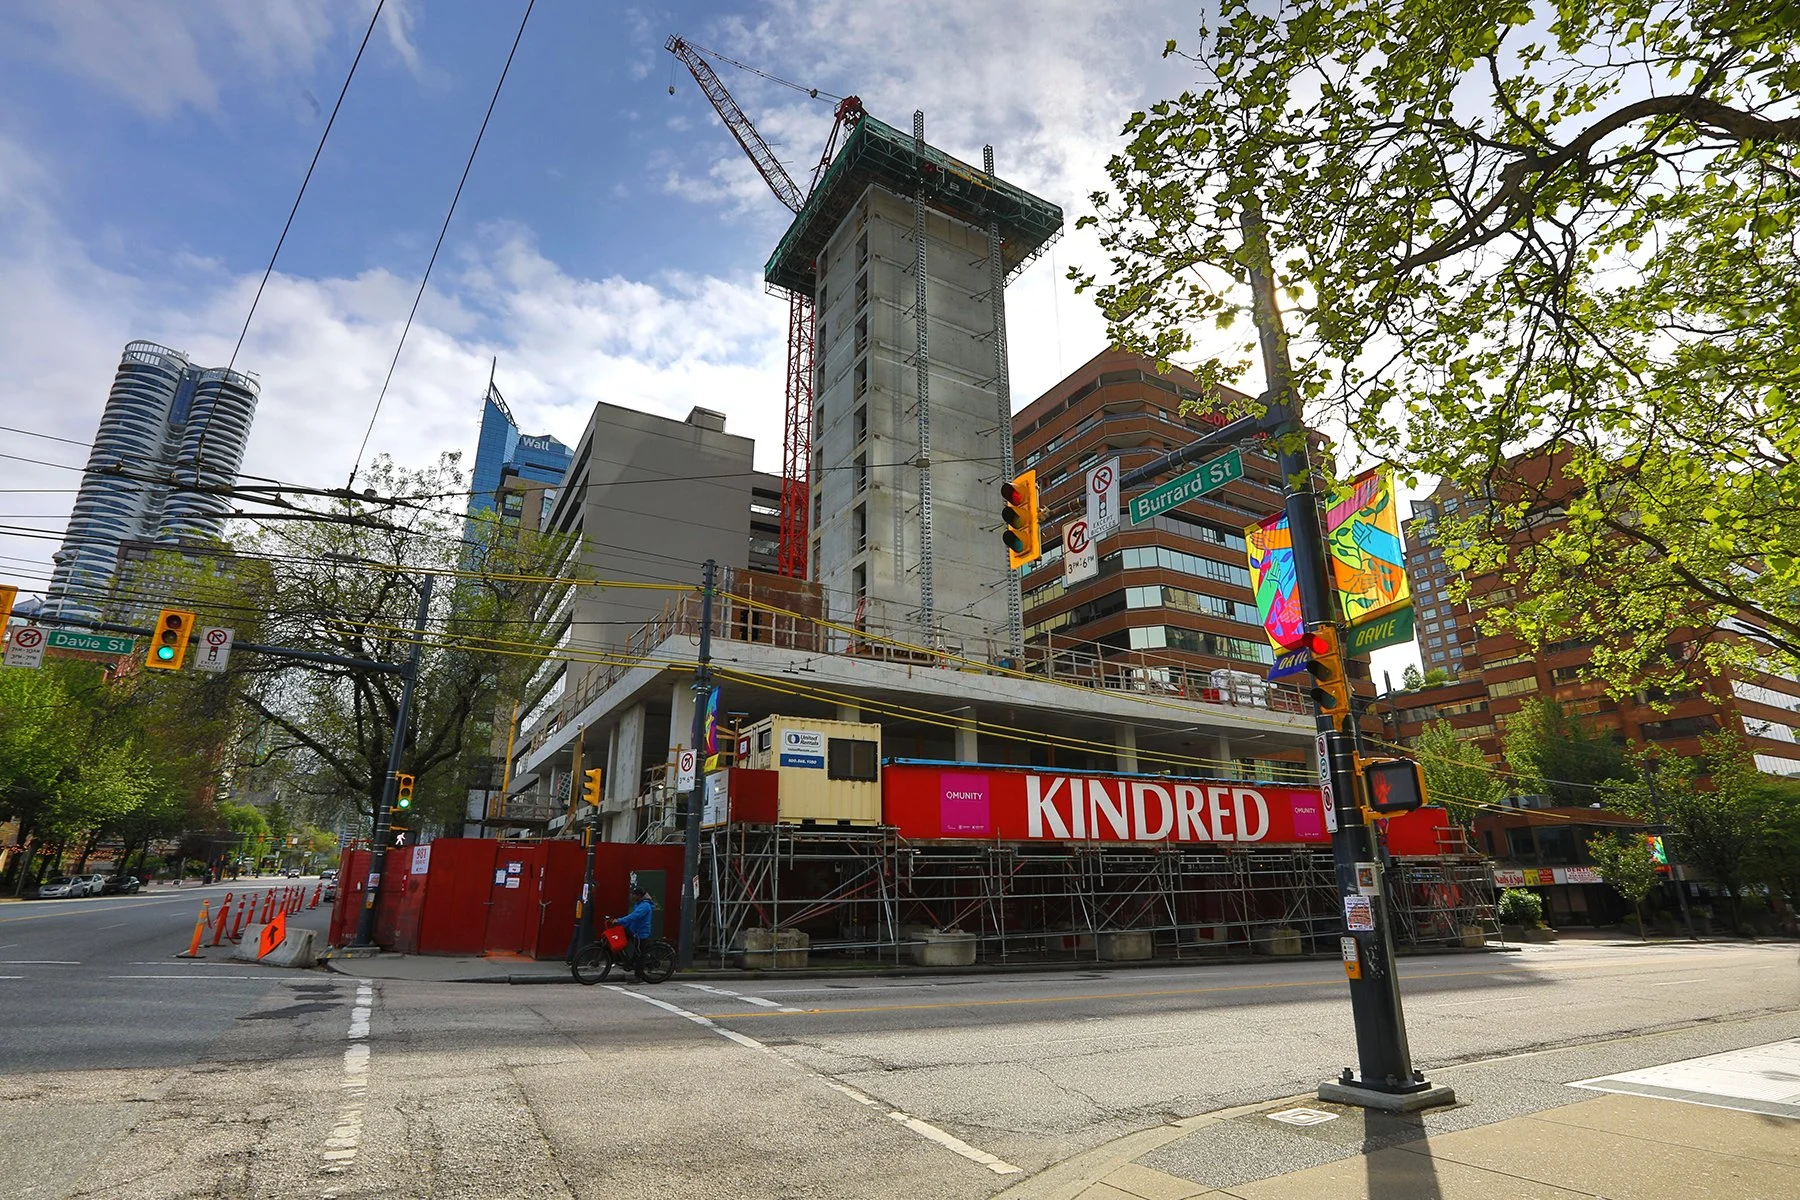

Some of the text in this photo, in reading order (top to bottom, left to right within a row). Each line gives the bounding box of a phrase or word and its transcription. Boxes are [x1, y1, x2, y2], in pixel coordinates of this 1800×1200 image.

[523, 437, 549, 450] Wall
[1138, 460, 1233, 518] Burrard St
[1090, 519, 1116, 536] BICYCLES
[1092, 514, 1113, 528] EXCEPT
[1355, 619, 1396, 647] DAVIE
[56, 634, 126, 651] Davie St
[1026, 775, 1270, 842] KINDRED
